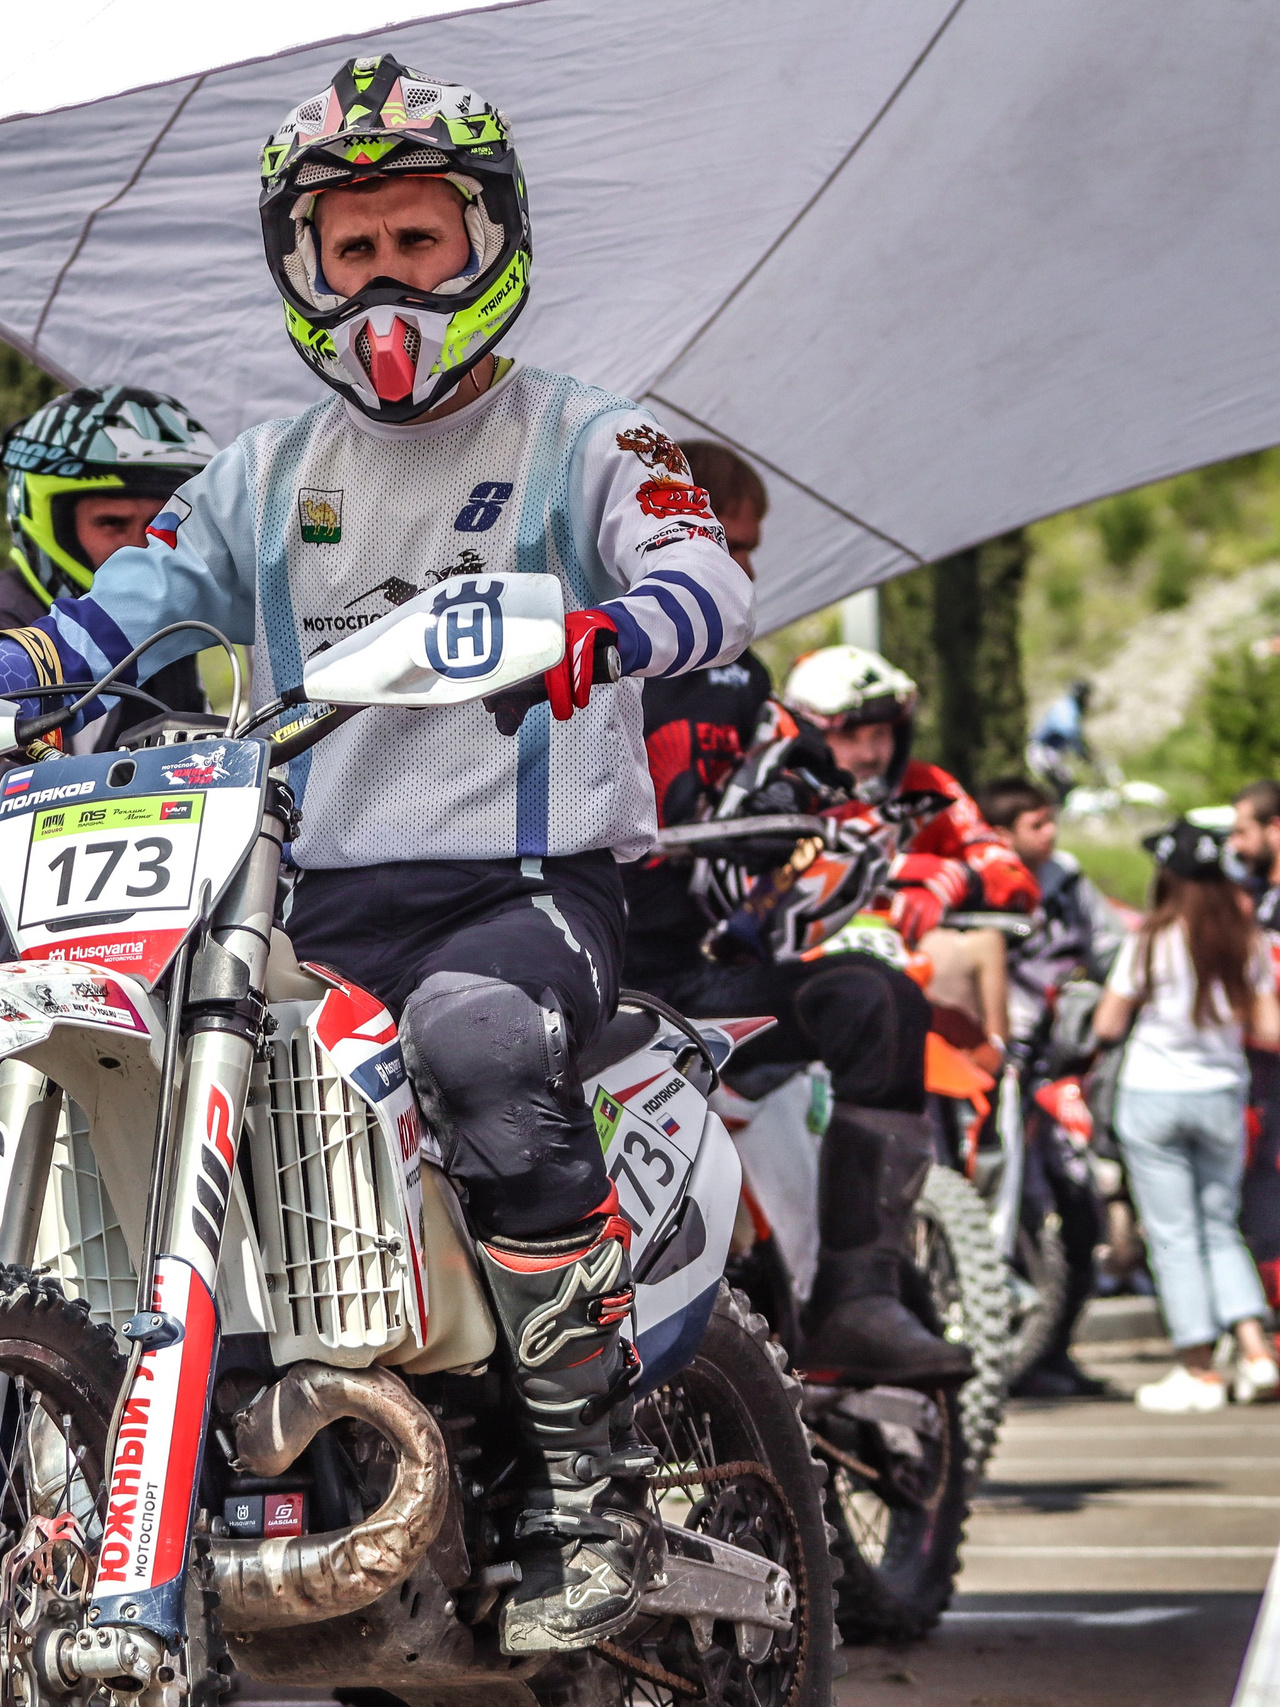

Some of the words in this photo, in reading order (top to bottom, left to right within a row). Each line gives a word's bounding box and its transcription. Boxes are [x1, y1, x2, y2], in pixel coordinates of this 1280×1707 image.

[453, 480, 514, 533] 8
[303, 612, 390, 631] МОТОСПО
[0, 779, 96, 815] ПОЛЯКОВ
[41, 827, 64, 836] ENDURO
[48, 836, 174, 907] 173
[69, 941, 144, 962] Husqvarna
[104, 954, 144, 963] MOTORCYCLES
[642, 1077, 686, 1115] ПОЛЯКОВ
[135, 1482, 158, 1578] МОТОСПОРТ
